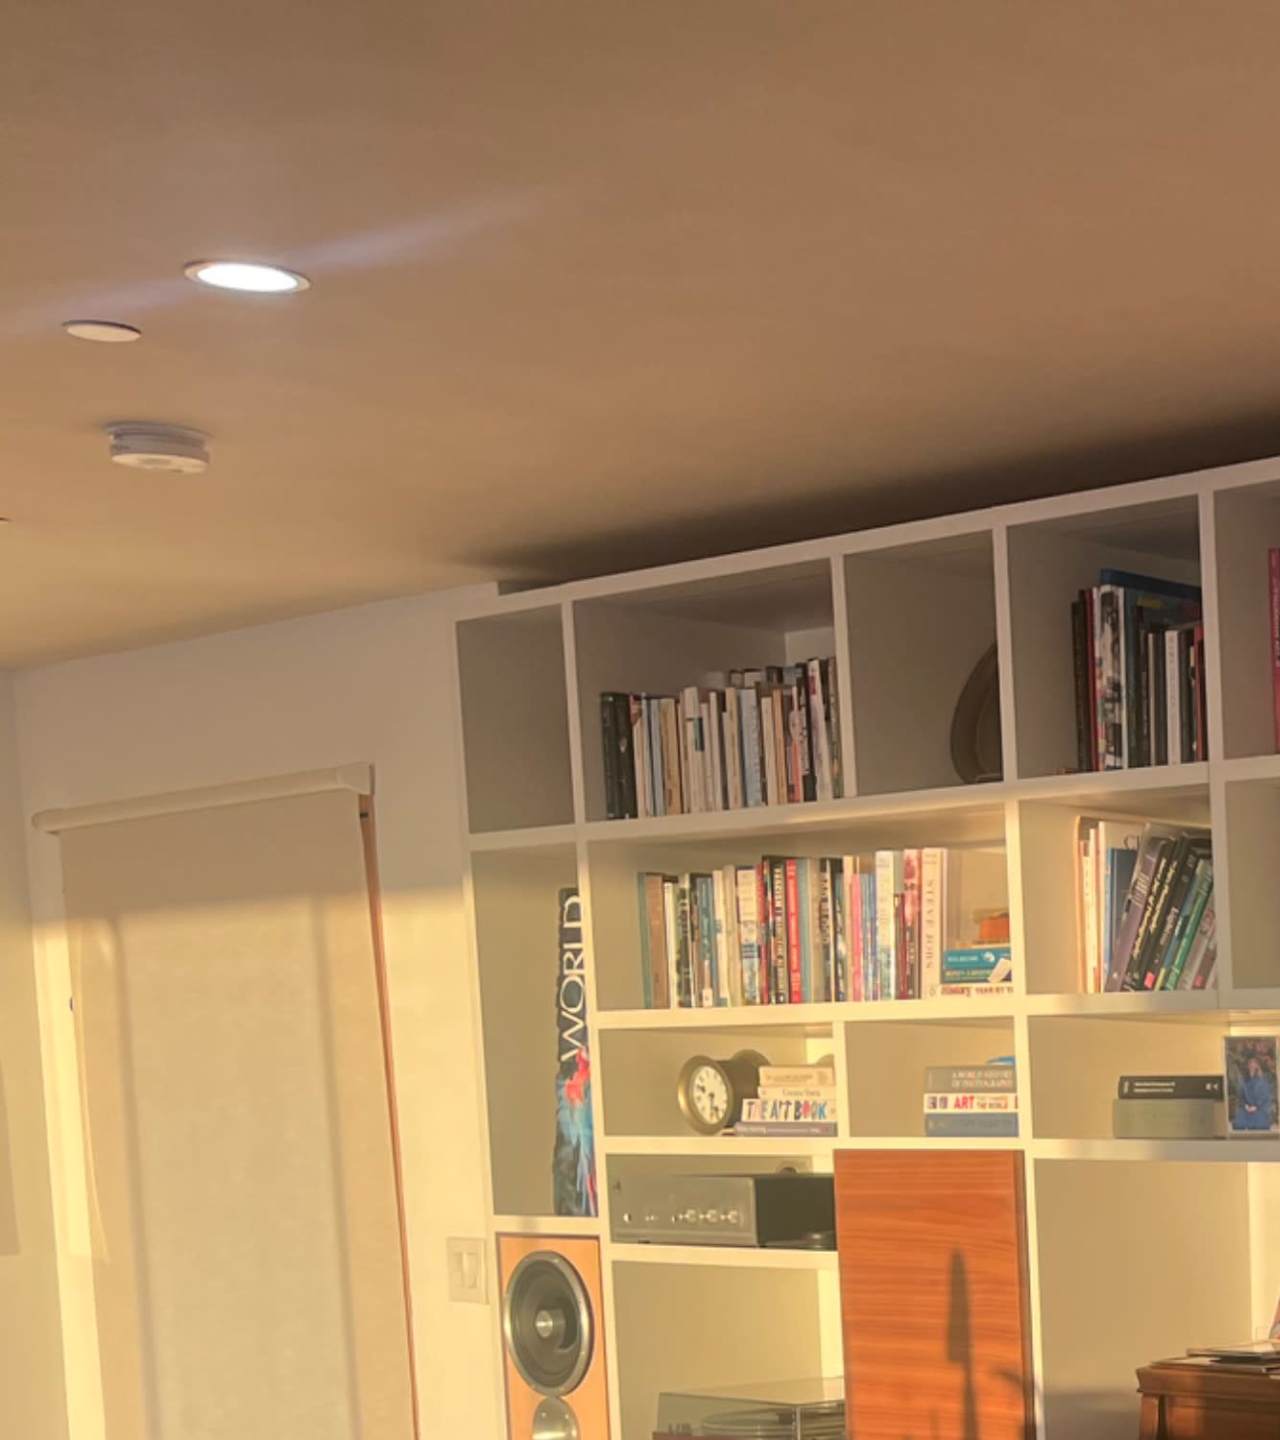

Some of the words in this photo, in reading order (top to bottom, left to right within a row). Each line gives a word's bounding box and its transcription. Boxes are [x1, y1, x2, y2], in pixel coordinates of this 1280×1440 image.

[926, 880, 936, 928] STEVE
[560, 896, 584, 1062] WORLD
[794, 1100, 828, 1120] BOOK
[954, 1096, 974, 1110] ART
